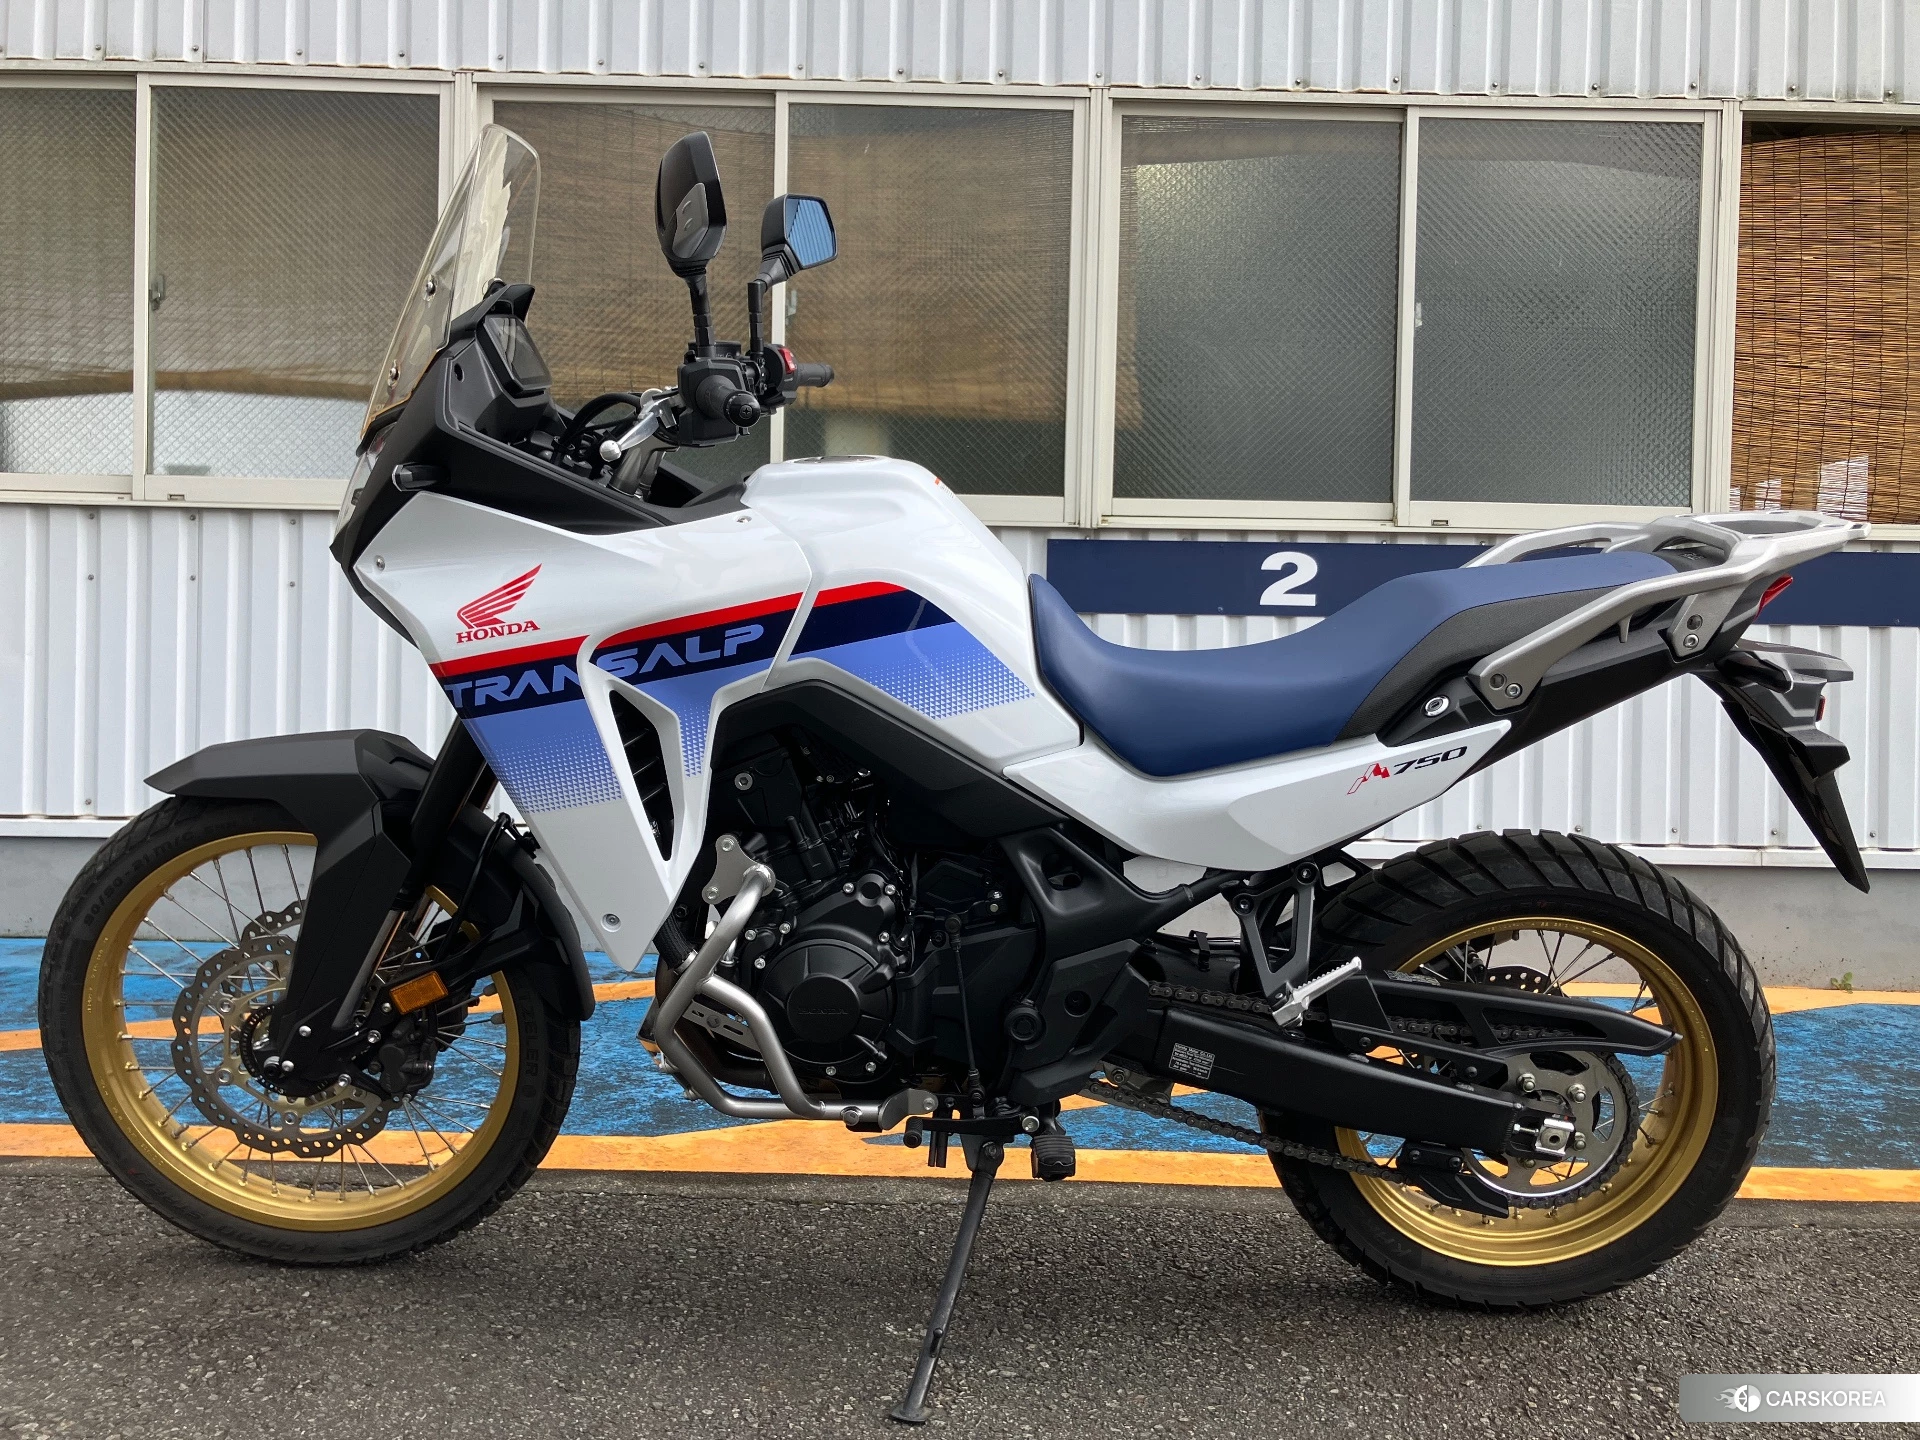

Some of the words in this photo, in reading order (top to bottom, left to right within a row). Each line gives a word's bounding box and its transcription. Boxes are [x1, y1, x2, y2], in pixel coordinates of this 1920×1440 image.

[1260, 551, 1318, 606] 2
[456, 619, 541, 644] HONDA
[444, 623, 765, 709] TRANSALP
[1393, 746, 1468, 775] 750
